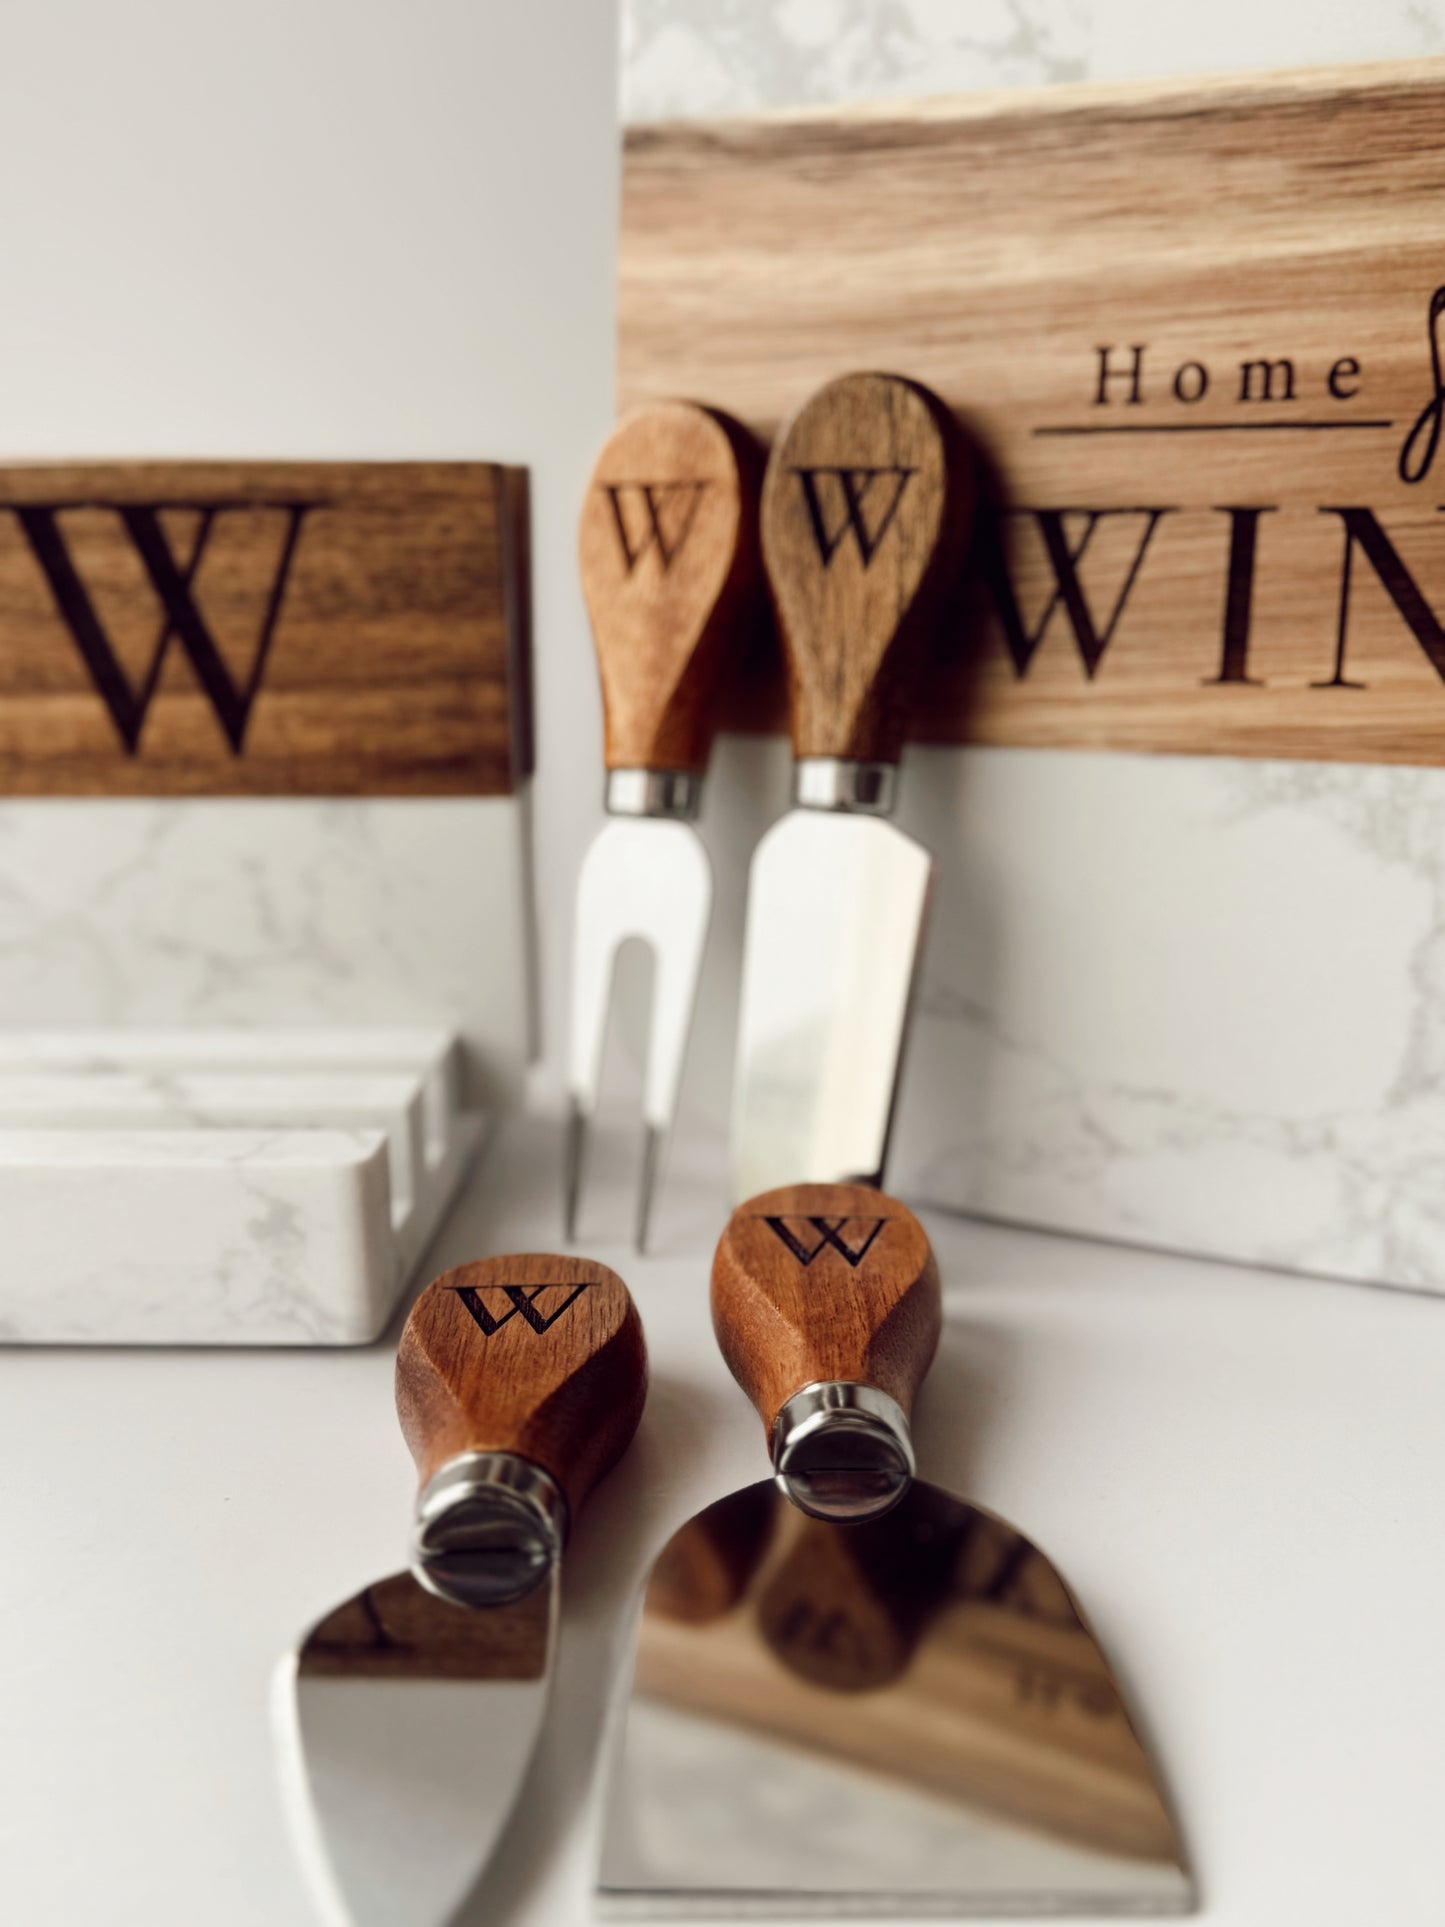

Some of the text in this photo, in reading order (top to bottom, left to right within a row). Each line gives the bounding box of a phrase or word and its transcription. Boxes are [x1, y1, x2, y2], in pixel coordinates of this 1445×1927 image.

[1090, 344, 1363, 406] Home
[601, 479, 711, 577] W
[788, 465, 917, 569] W
[0, 499, 330, 757] W
[752, 1214, 894, 1267] W
[442, 1282, 600, 1337] W
